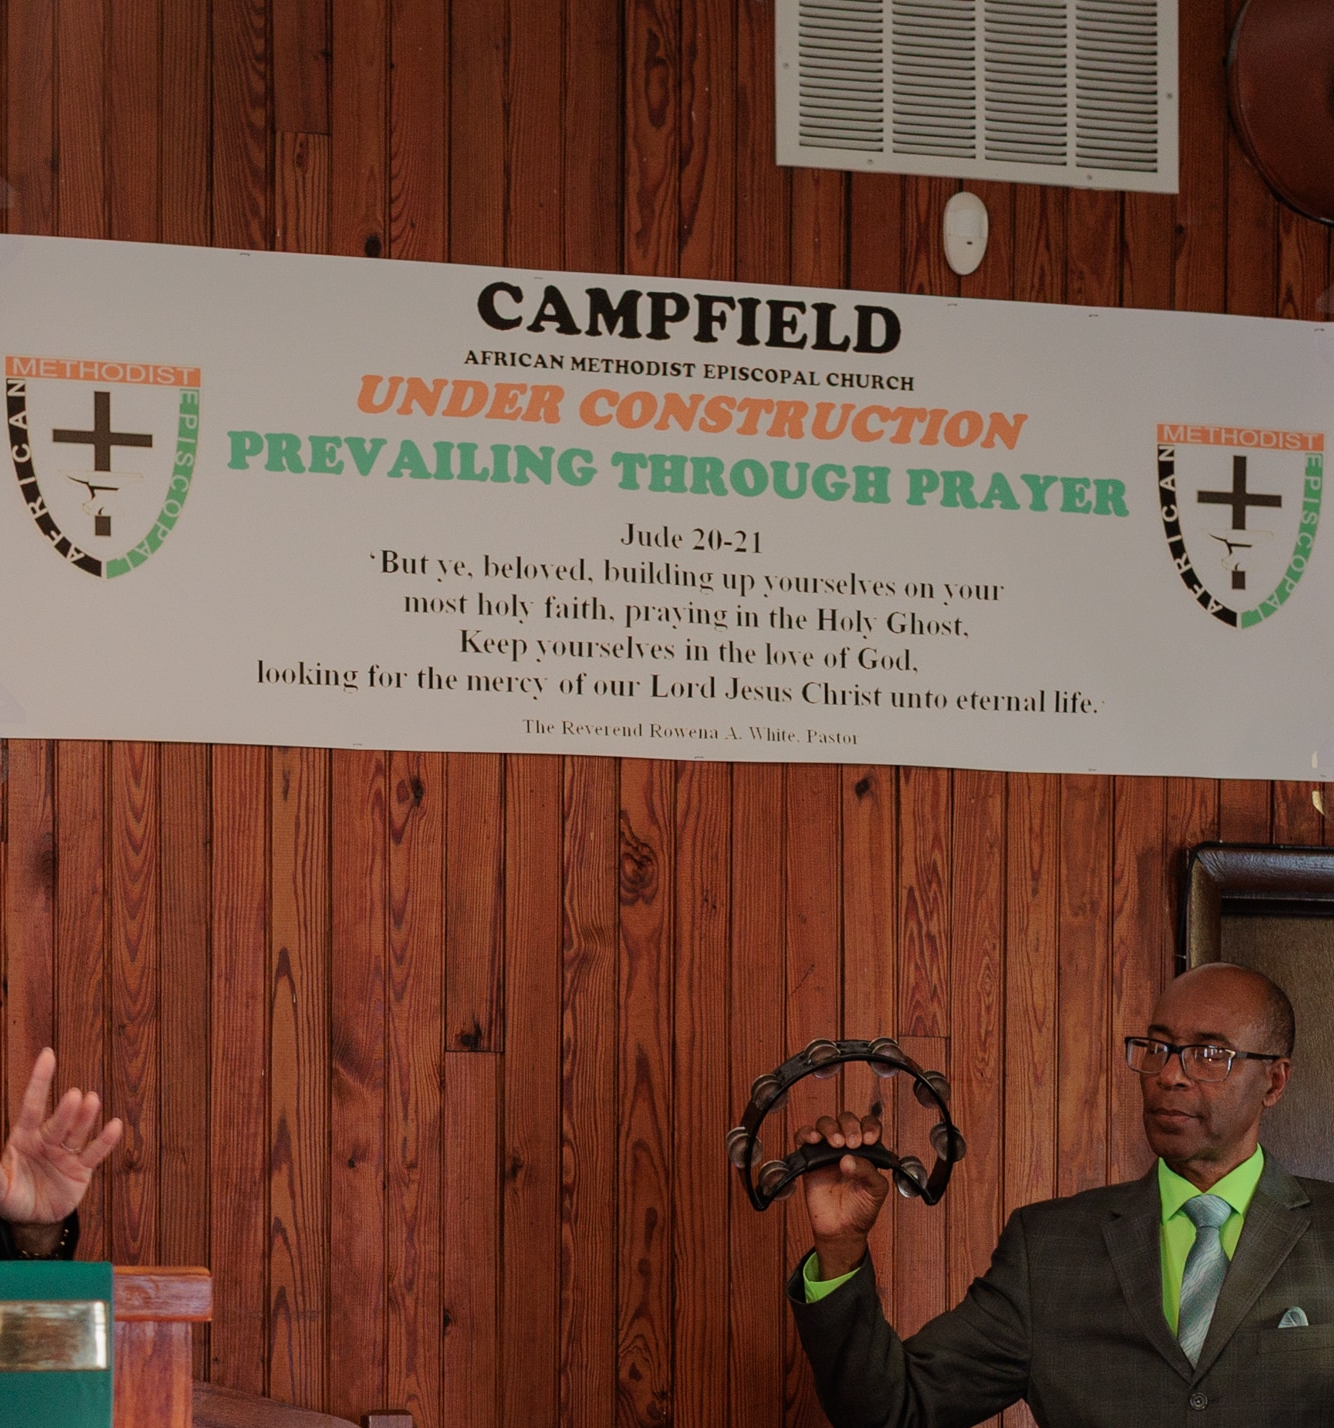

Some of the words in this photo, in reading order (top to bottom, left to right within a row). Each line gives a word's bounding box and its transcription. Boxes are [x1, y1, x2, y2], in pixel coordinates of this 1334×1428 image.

[477, 281, 902, 354] CAMPFIELD
[12, 358, 195, 386] METHODIST
[464, 350, 565, 370] AFRICAN
[571, 356, 696, 377] METHODIST
[703, 364, 820, 386] EPISCOPAL
[826, 373, 914, 391] CHURCH
[357, 375, 564, 425] UNDER
[579, 389, 1028, 450] CONSTRUCTION
[1163, 425, 1318, 450] METHODIST
[7, 379, 85, 562] AFRICAN
[116, 390, 198, 571] EPISCOPAL
[227, 431, 597, 486] PREVAILING
[611, 452, 891, 504] THROUGH
[906, 469, 1129, 517] PRAYER
[621, 523, 683, 549] Jude
[693, 528, 761, 553] 20-21
[1158, 445, 1223, 613] AFRICAN
[1250, 454, 1322, 621] EPISCOPAL
[484, 555, 593, 583] beloved,
[605, 559, 714, 592] building
[723, 574, 755, 597] up
[764, 573, 895, 598] yourselves
[905, 583, 934, 598] on
[944, 584, 1004, 606] your
[405, 595, 467, 614] most
[478, 592, 537, 624] holy
[545, 596, 614, 621] faith,
[626, 602, 728, 630] praying
[737, 605, 758, 627] in
[769, 607, 807, 629] the
[818, 608, 876, 639] Holy
[887, 612, 968, 637] Ghost,
[460, 630, 527, 662] Keep
[536, 636, 674, 662] yourselves
[686, 638, 708, 661] in
[719, 640, 756, 664] the
[766, 643, 814, 667] love
[824, 647, 850, 668] of
[858, 647, 918, 672] God,
[258, 660, 358, 694] looking
[368, 664, 407, 688] for
[418, 666, 457, 690] the
[467, 675, 547, 700] mercy
[560, 672, 587, 695] of
[594, 680, 640, 696] our
[651, 675, 715, 698] Lord
[725, 677, 792, 702] Jesus
[802, 682, 882, 706] Christ
[891, 690, 947, 708] unto
[957, 690, 1045, 712] eternal
[523, 719, 555, 735] The
[562, 721, 642, 736] Reverend
[651, 724, 718, 739] Rowena
[808, 730, 857, 744] Pastor
